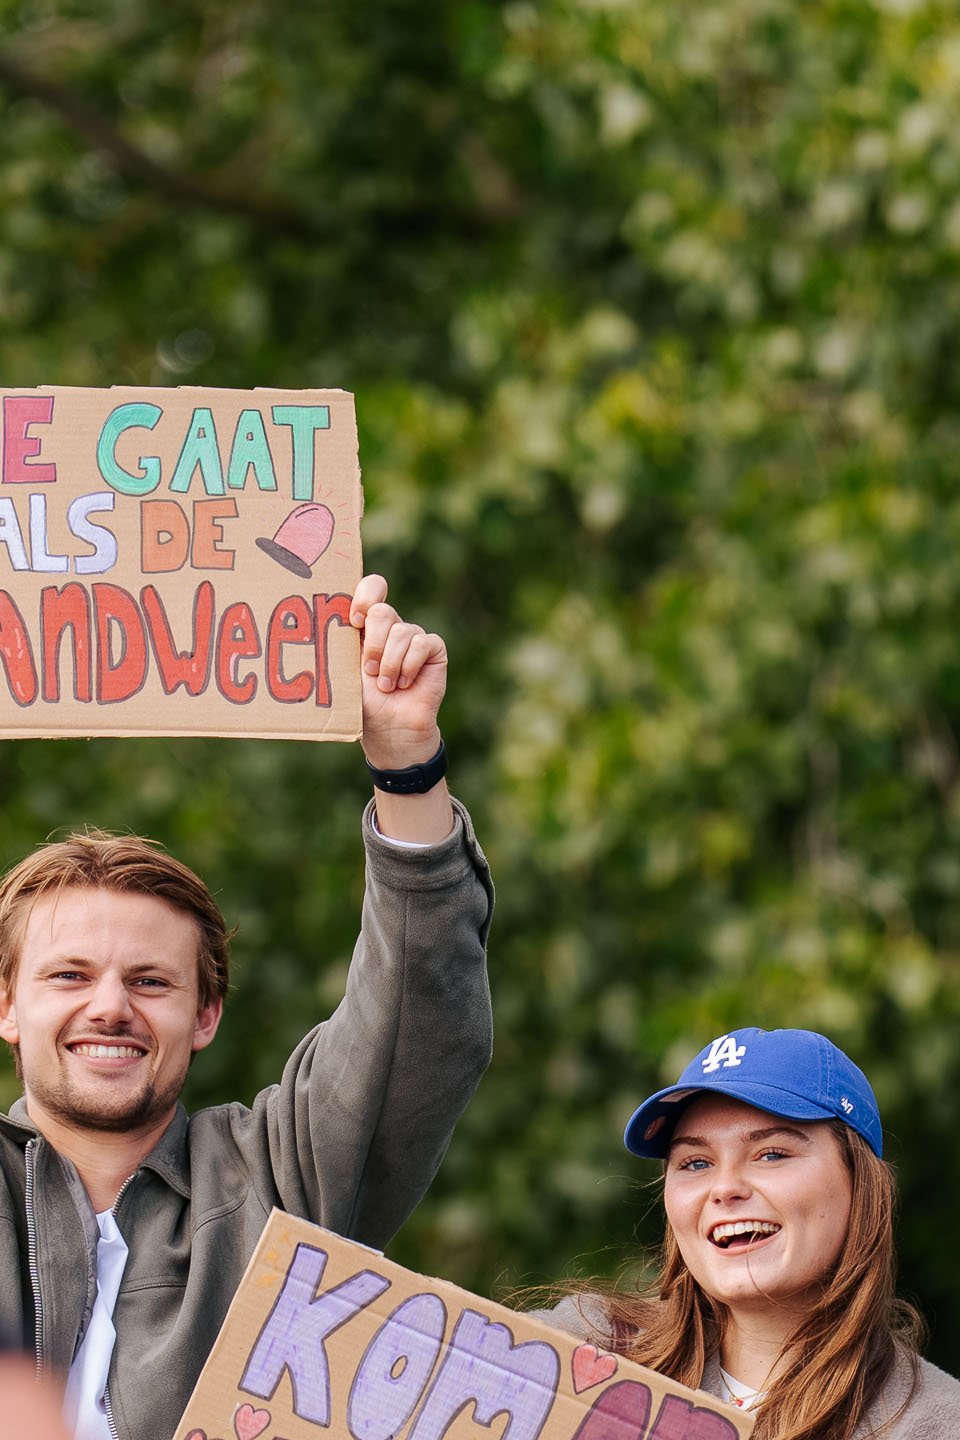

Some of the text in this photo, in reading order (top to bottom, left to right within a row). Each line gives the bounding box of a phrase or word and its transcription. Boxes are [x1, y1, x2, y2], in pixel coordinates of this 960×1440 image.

[96, 402, 331, 500] GAAT
[140, 498, 239, 573] DE
[702, 1035, 746, 1073] LA
